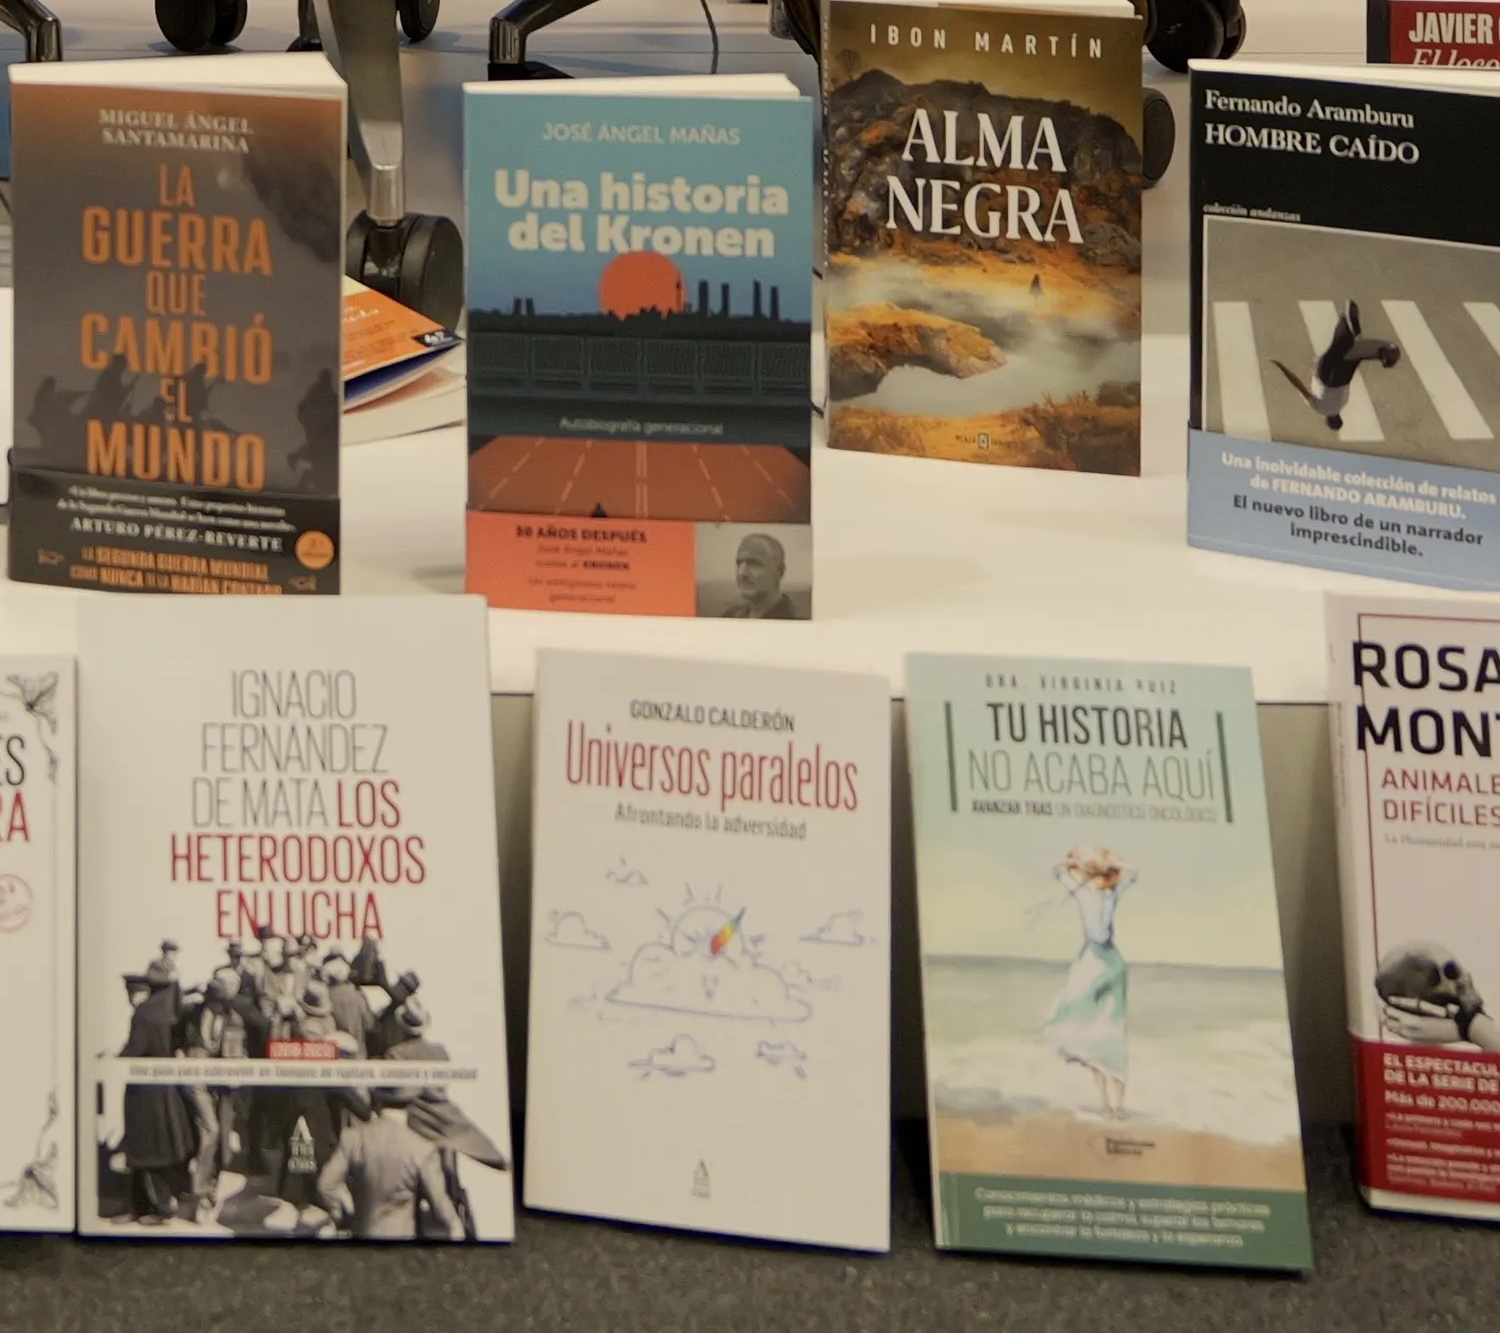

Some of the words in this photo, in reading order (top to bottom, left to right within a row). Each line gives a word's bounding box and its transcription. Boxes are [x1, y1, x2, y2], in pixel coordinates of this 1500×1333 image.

[868, 22, 949, 50] IBON
[974, 30, 1105, 61] MARTÍN
[1408, 11, 1494, 45] JAVIER
[542, 119, 592, 144] JOSÉ
[598, 119, 664, 145] ÁNGEL
[670, 121, 741, 146] MAÑAS
[1204, 88, 1302, 118] Fernando
[1306, 97, 1415, 130] Aramburu
[901, 106, 1068, 173] ALMA
[1204, 122, 1323, 155] HOMBRE
[1328, 133, 1421, 165] CAÍDO
[158, 162, 197, 208] LA
[493, 168, 589, 210] Una
[601, 170, 790, 217] historia
[885, 174, 1085, 246] NEGRA
[81, 205, 274, 277] GUERRA
[507, 213, 585, 253] del
[597, 215, 775, 259] Kronen
[145, 269, 208, 318] QUE
[79, 312, 274, 387] CAMBIÓ
[85, 419, 266, 492] MUNDO
[69, 517, 141, 536] ARTURO
[143, 523, 284, 553] PÉREZ-REVERTE
[1233, 494, 1248, 510] El
[1252, 499, 1305, 519] nuevo
[1308, 504, 1349, 526] libro
[1353, 512, 1375, 530] de
[1379, 519, 1402, 534] un
[1405, 522, 1484, 547] narrador
[230, 668, 358, 720] IGNACIO
[1039, 674, 1124, 693] VIRGINIA
[1135, 678, 1177, 695] RUIZ
[200, 719, 390, 774] FERNÁNDEZ
[986, 702, 1028, 744] TU
[1037, 702, 1189, 749] HISTORIA
[565, 720, 712, 797] Universos
[719, 739, 860, 814] paralelos
[967, 748, 1013, 793] NO
[1022, 749, 1133, 797] ACABA
[1141, 747, 1216, 802] AQUÍ
[191, 778, 236, 829] DE
[241, 777, 330, 829] MATA
[336, 779, 402, 829] LOS
[169, 833, 427, 885] HETERODOXOS
[216, 889, 259, 940] EN
[1382, 1068, 1406, 1084] DE
[1408, 1071, 1430, 1087] LA
[1431, 1073, 1476, 1093] SERIE
[1477, 1077, 1500, 1095] DE
